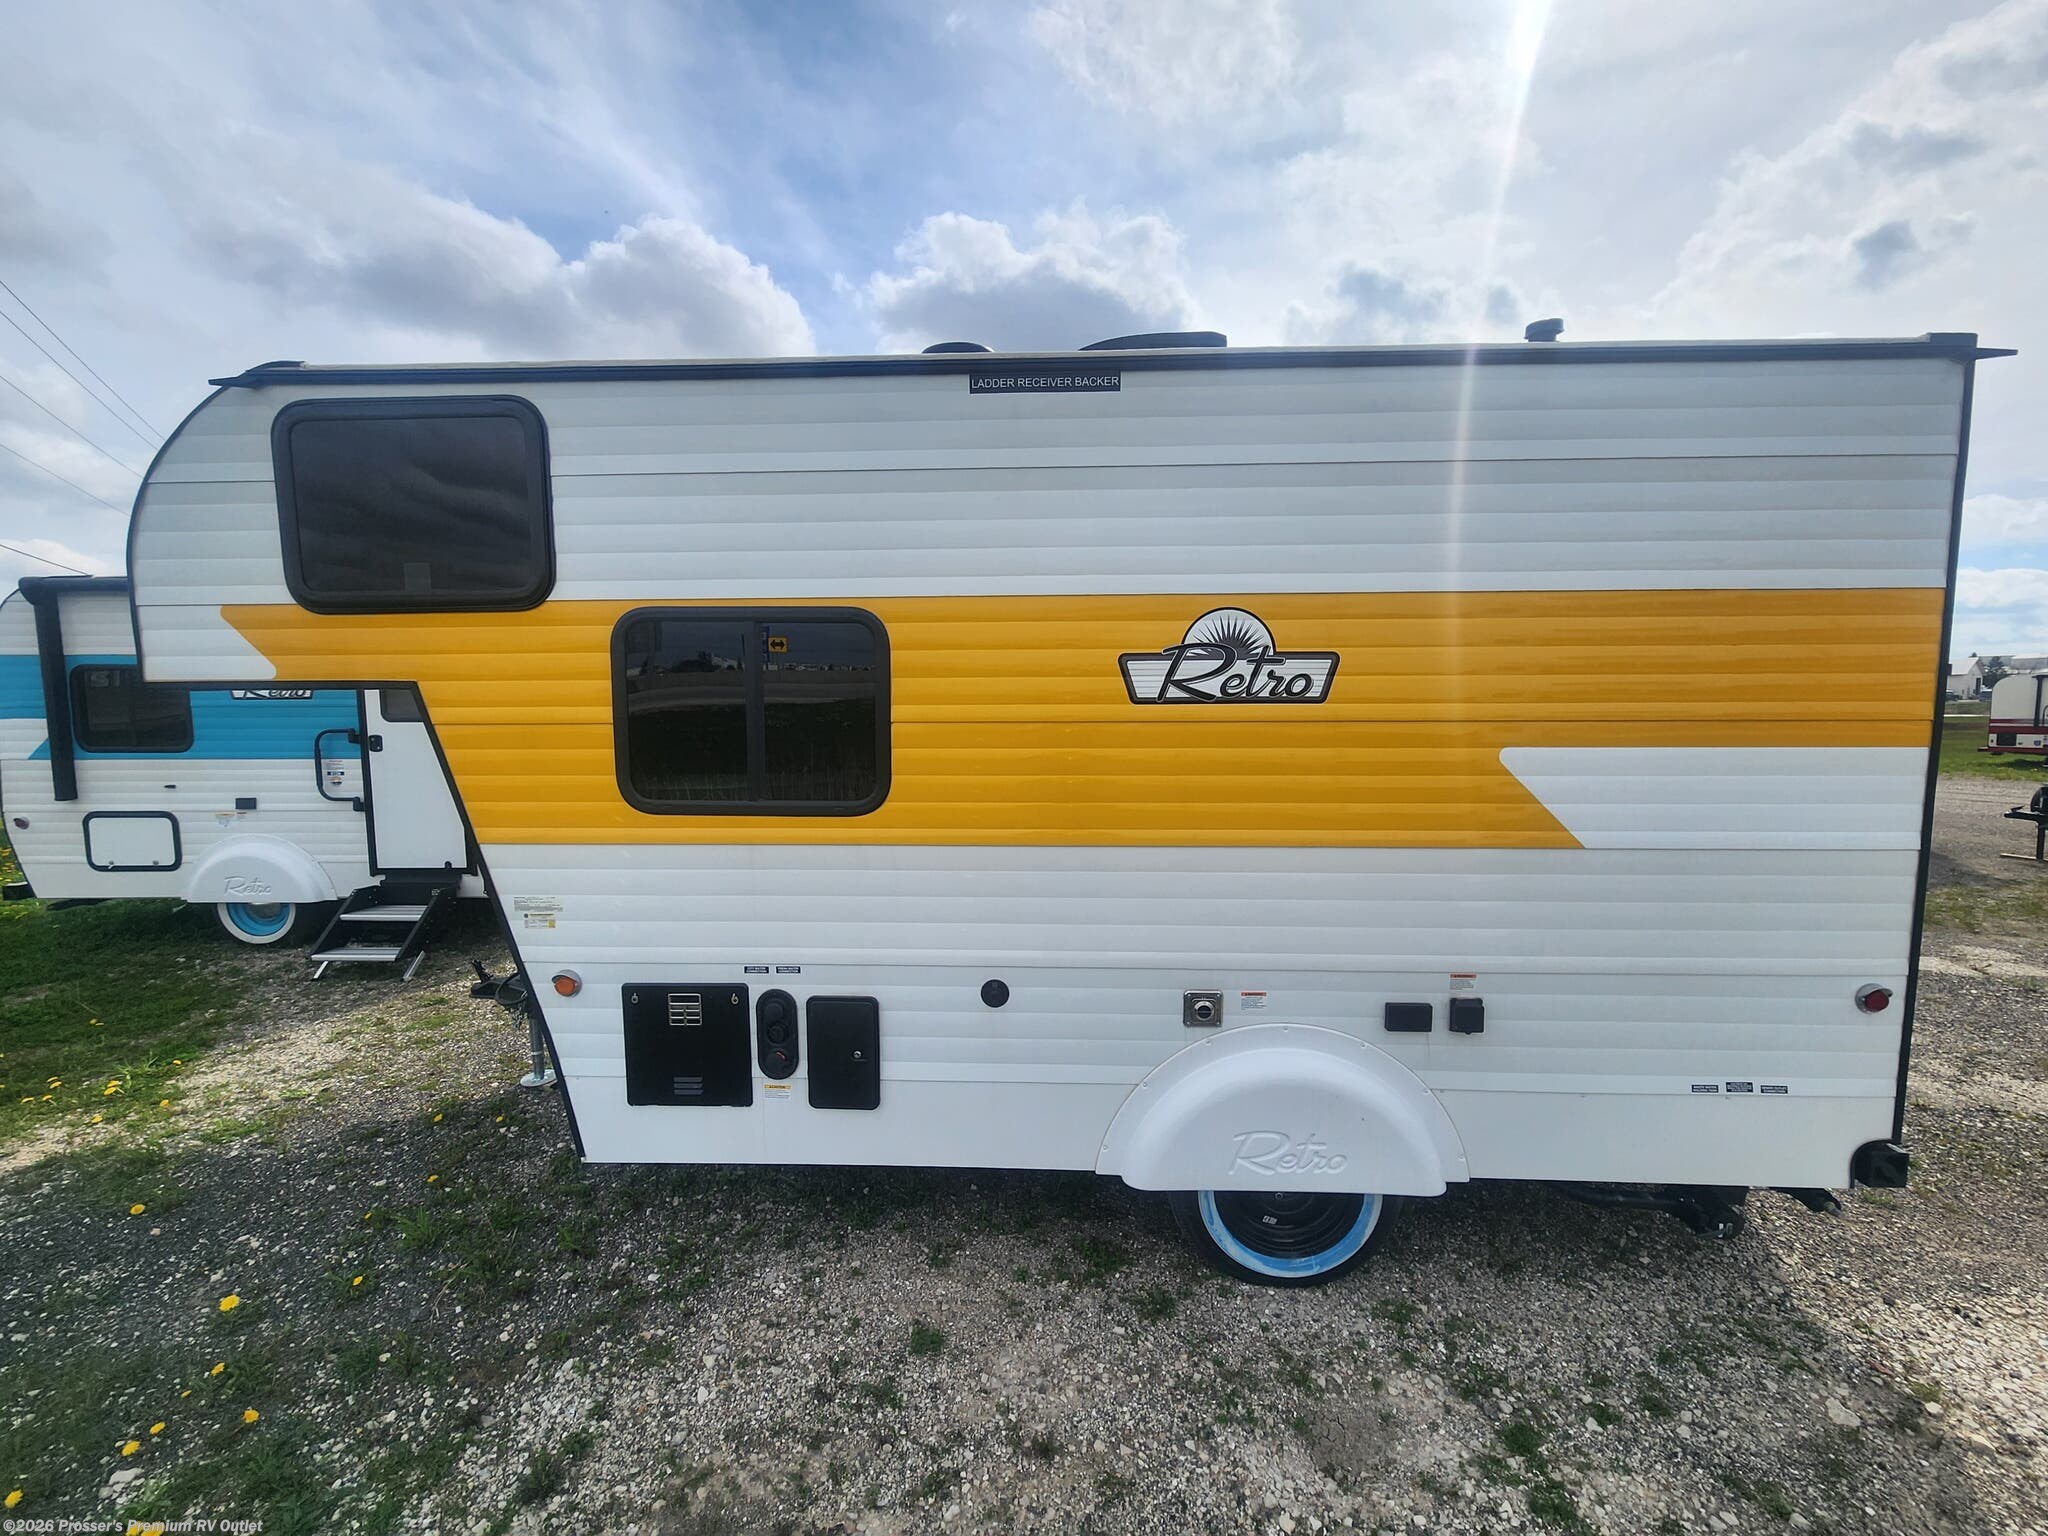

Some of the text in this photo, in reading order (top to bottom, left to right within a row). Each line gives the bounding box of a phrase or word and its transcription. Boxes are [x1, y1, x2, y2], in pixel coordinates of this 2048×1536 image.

[971, 376, 1120, 389] LADDER RECEIVER BACKER
[1157, 642, 1314, 702] Retro
[223, 875, 272, 897] Retro
[1227, 1130, 1348, 1176] Retro
